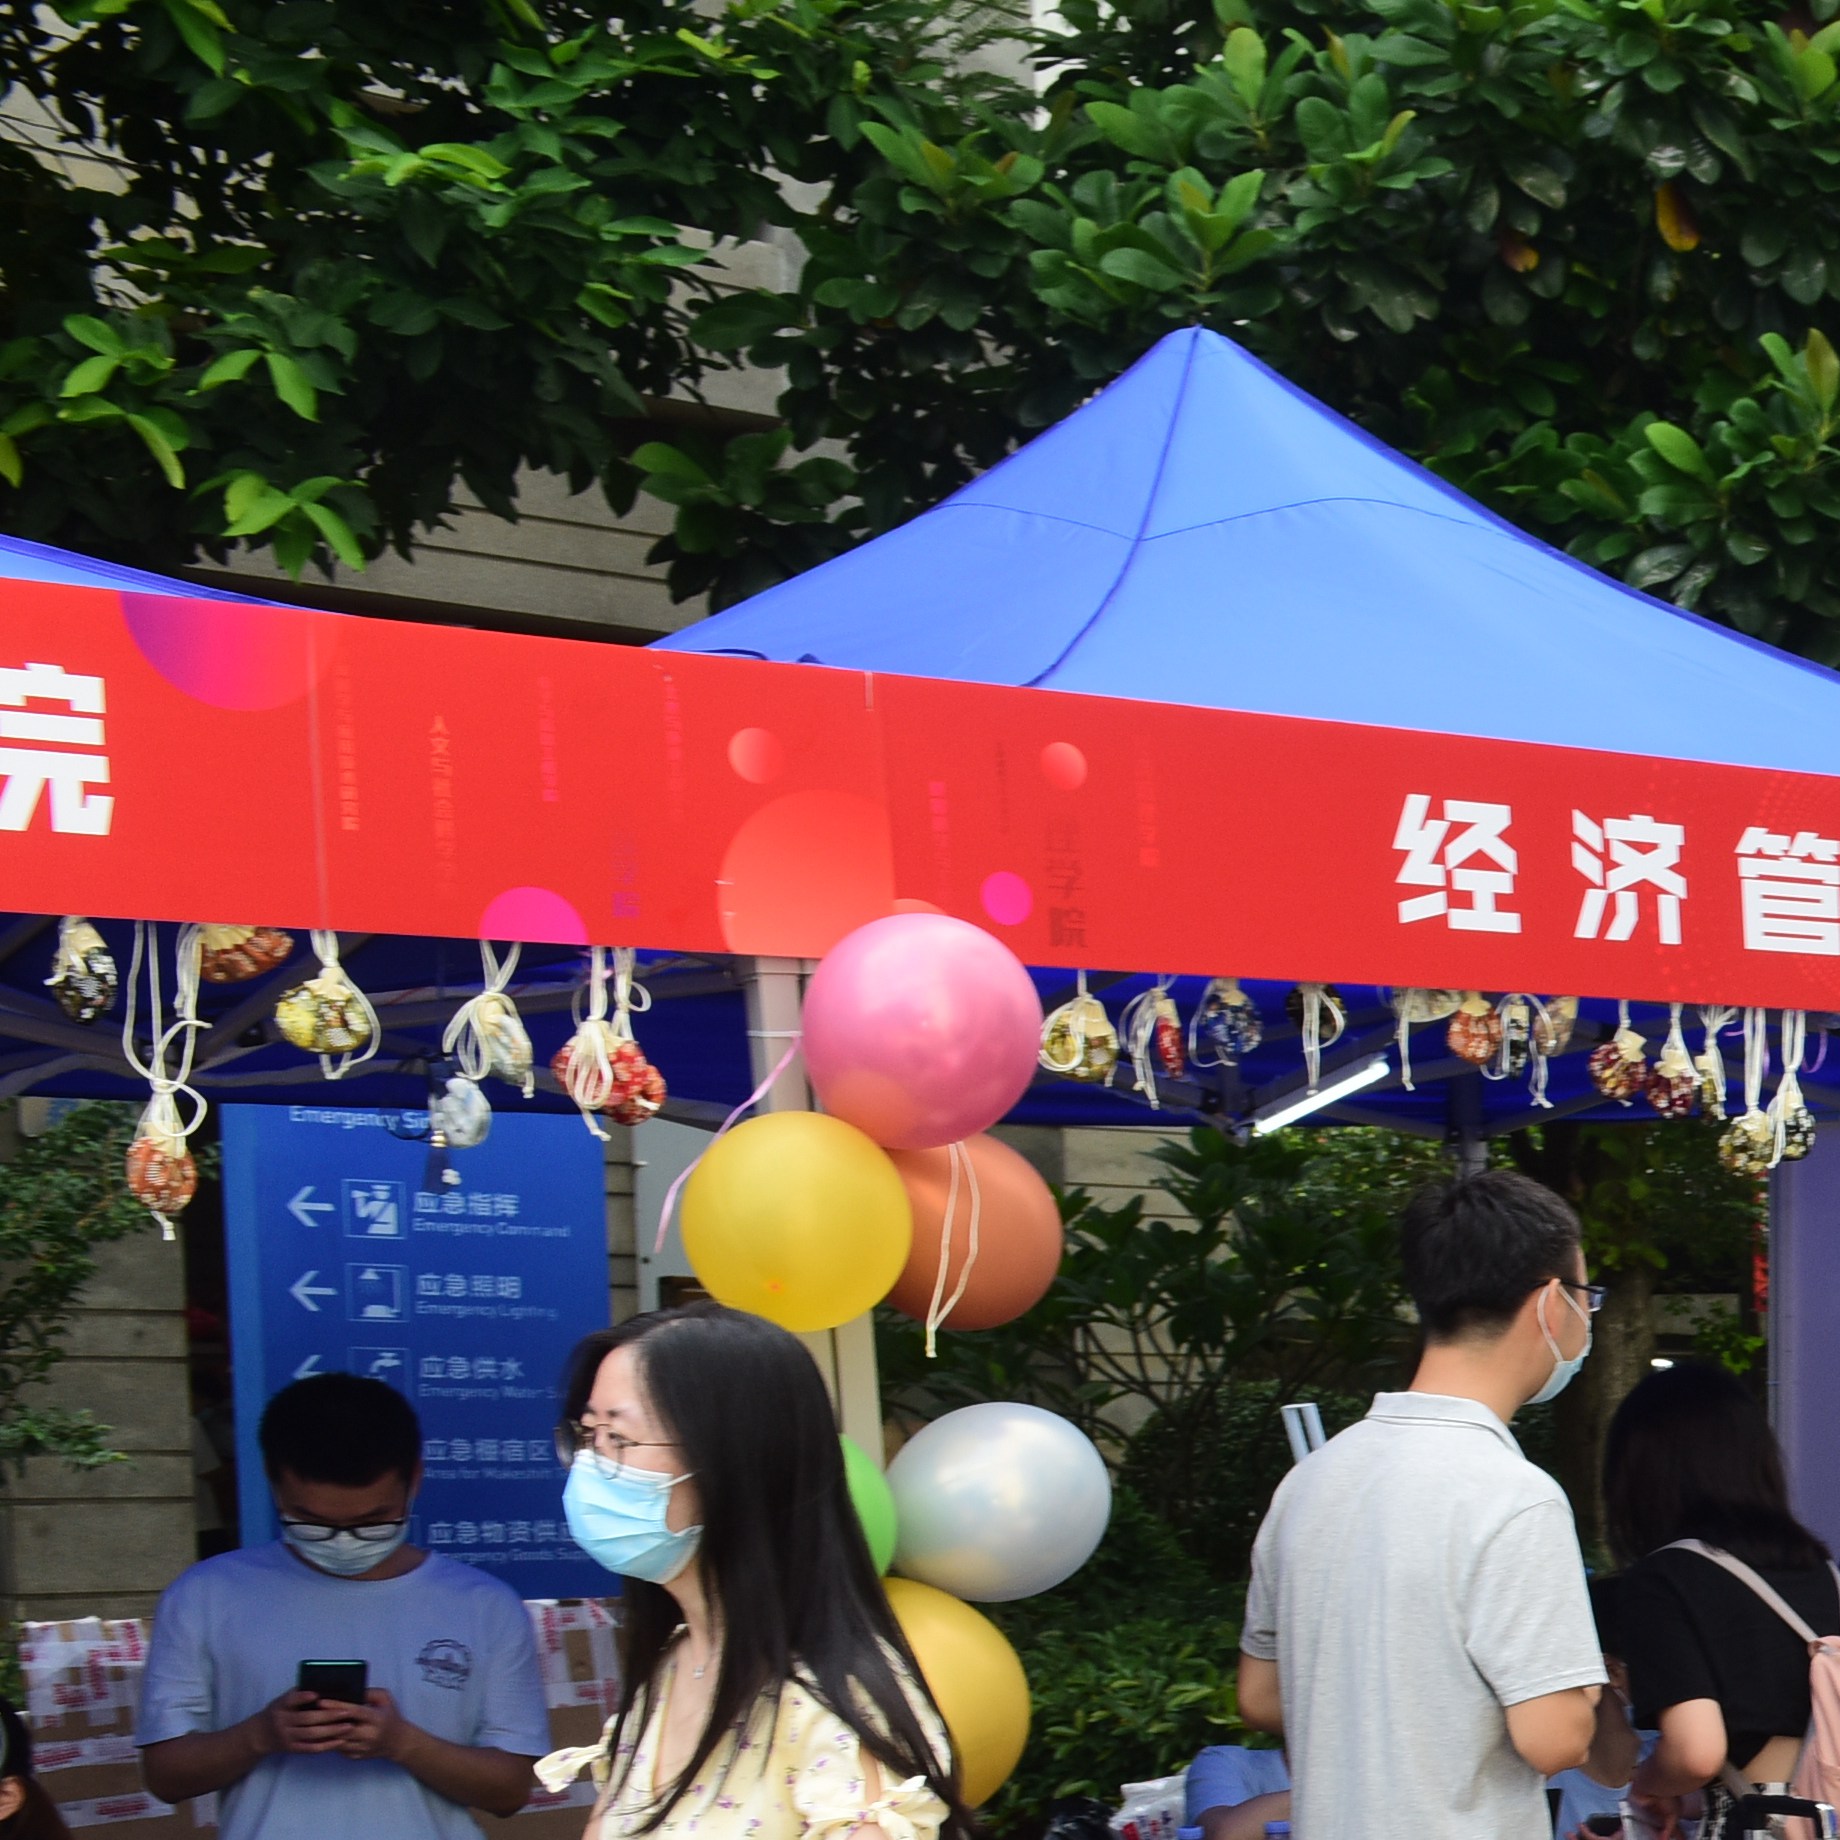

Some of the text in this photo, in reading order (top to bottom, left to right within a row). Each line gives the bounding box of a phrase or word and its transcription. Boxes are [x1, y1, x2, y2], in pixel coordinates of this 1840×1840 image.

[412, 1191, 521, 1218] 应急指挥
[416, 1272, 522, 1299] 应急照明
[419, 1355, 525, 1381] 应急供水
